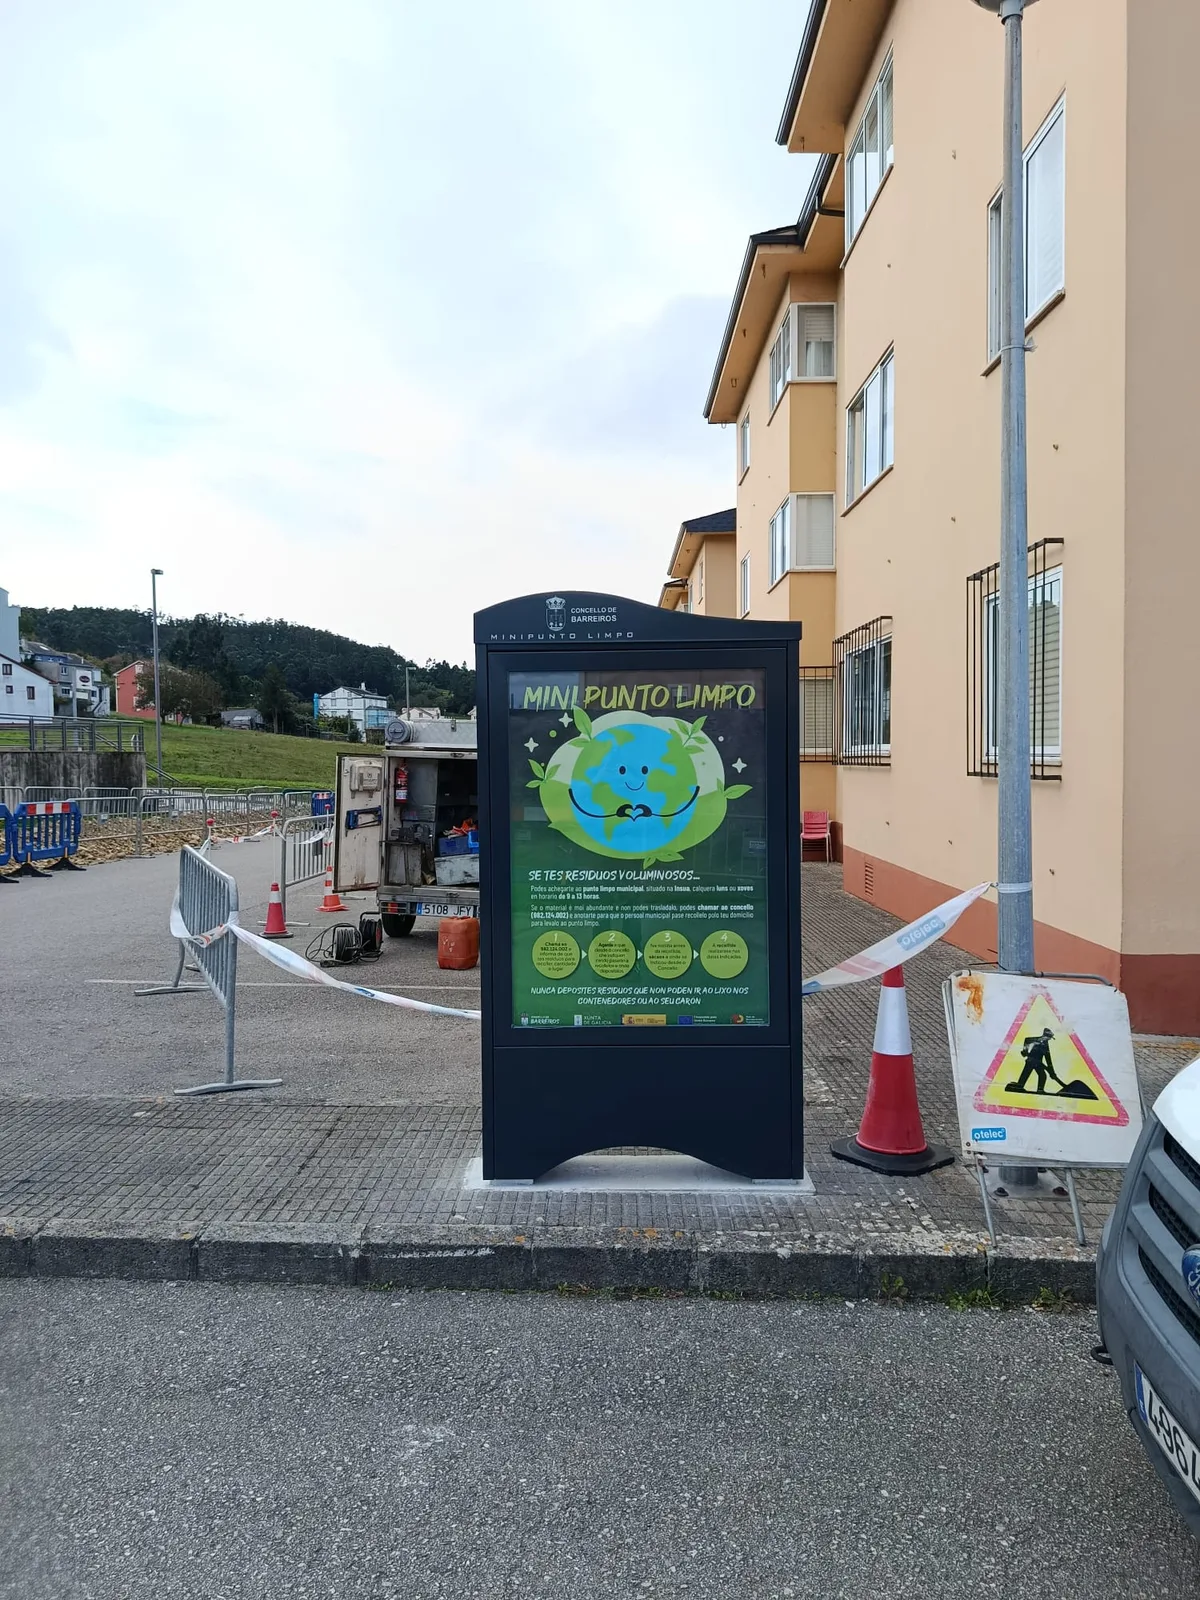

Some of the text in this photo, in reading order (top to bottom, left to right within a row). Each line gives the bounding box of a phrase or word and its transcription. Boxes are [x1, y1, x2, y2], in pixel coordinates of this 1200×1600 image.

[524, 684, 756, 712] MINI PUNTO LIMPO
[528, 870, 542, 880] SE
[544, 870, 564, 882] TES
[565, 870, 617, 882] RESIDUOS
[424, 904, 472, 916] 5108 JFY
[608, 932, 616, 942] 2
[664, 932, 671, 942] 3
[720, 932, 728, 942] 4
[598, 986, 633, 995] RESIDUOS
[974, 1128, 1004, 1140] otelec
